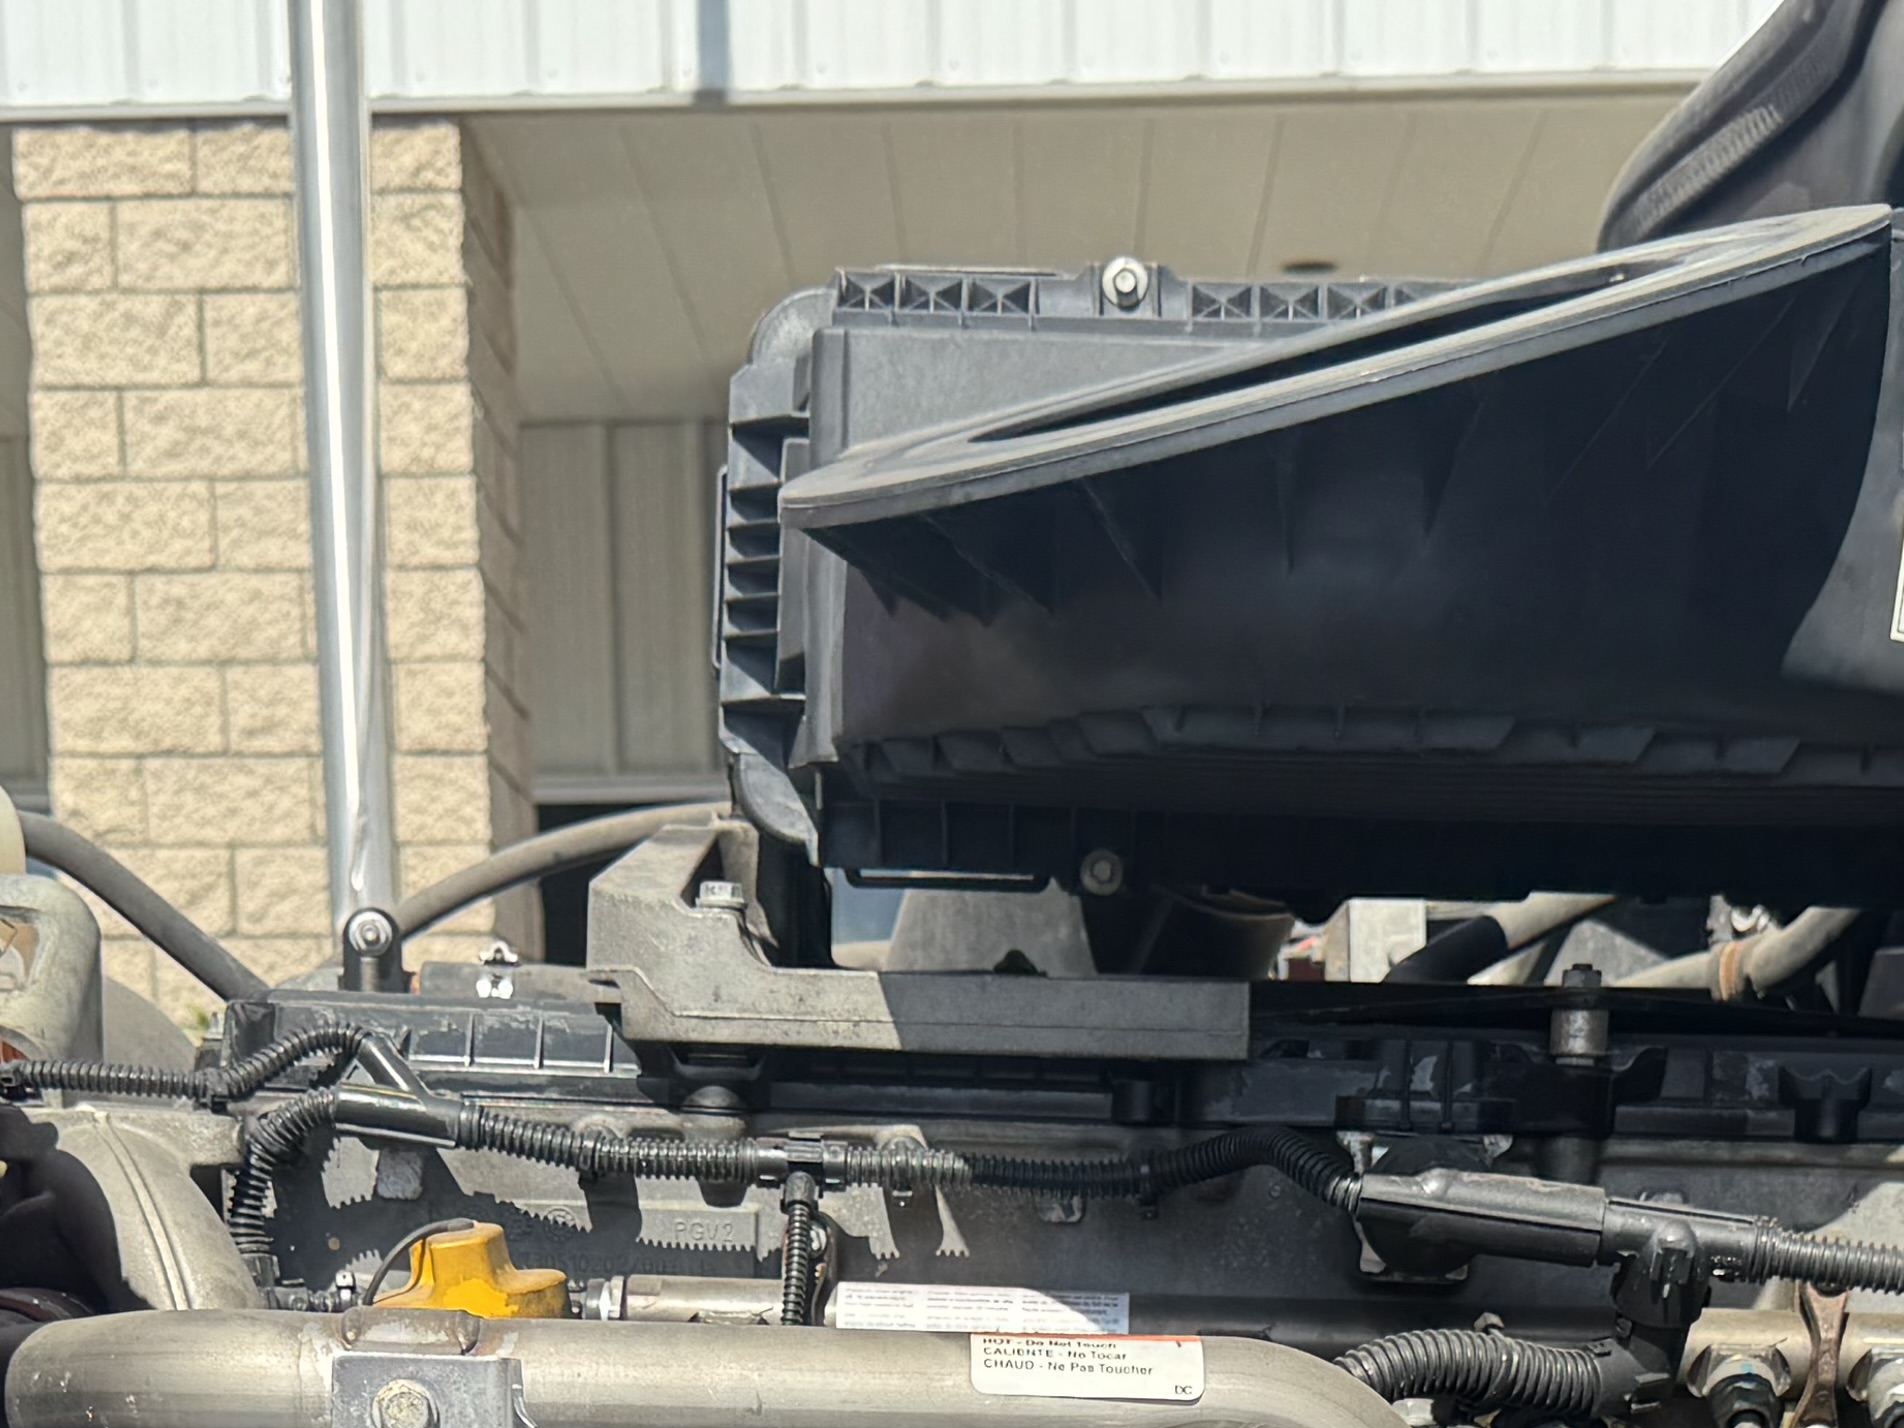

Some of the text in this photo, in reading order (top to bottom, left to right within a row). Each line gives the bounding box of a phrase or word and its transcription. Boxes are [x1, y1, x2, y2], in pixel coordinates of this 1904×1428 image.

[673, 1218, 735, 1244] PGV2
[984, 1347, 1053, 1358] CALIENTE
[1068, 1350, 1086, 1360] No
[1091, 1350, 1127, 1361] Tocar
[984, 1358, 1035, 1370] CHAUD
[1071, 1362, 1095, 1373] Pas
[1099, 1363, 1153, 1375] Toucher
